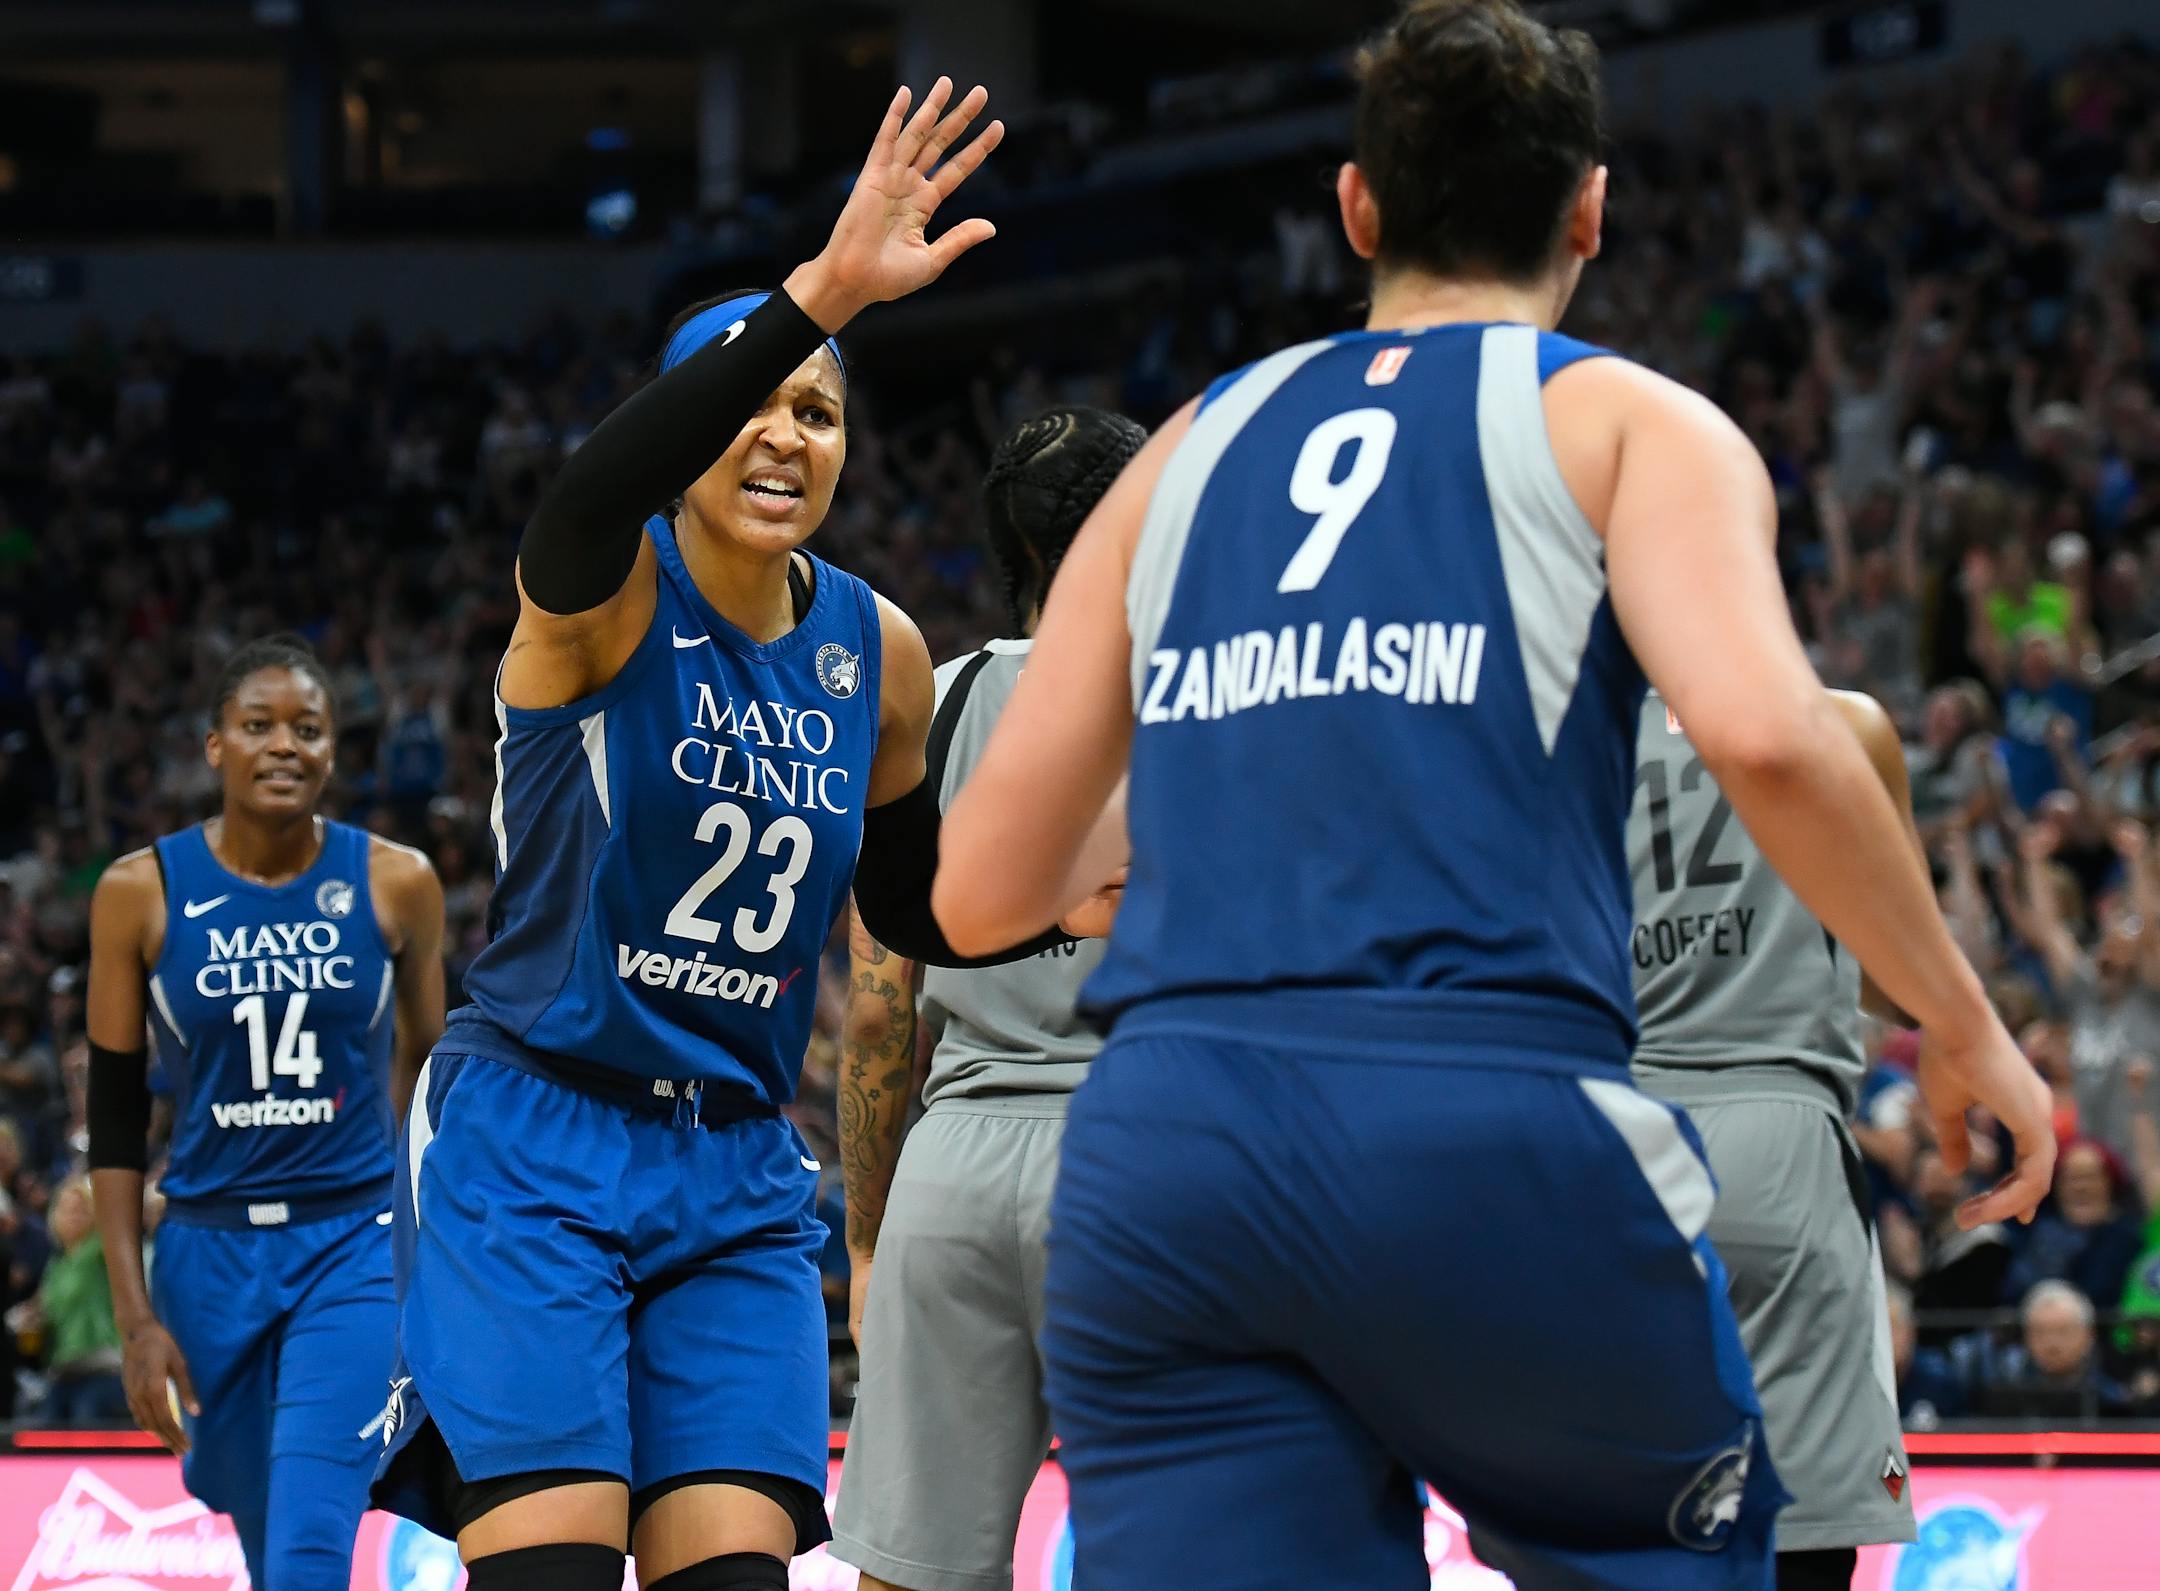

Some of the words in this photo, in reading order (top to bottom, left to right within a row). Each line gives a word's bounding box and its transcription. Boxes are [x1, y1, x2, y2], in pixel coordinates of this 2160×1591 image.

[1277, 407, 1397, 593] 9
[1141, 617, 1487, 725] ZANDALASINI
[691, 682, 834, 755] MAYO
[671, 737, 849, 815] CLINIC
[664, 802, 813, 953] 23
[195, 956, 355, 998] CLINIC
[206, 921, 341, 961] MAYO
[617, 943, 778, 1009] verizon
[233, 992, 323, 1090] 14
[211, 1092, 334, 1128] verizon
